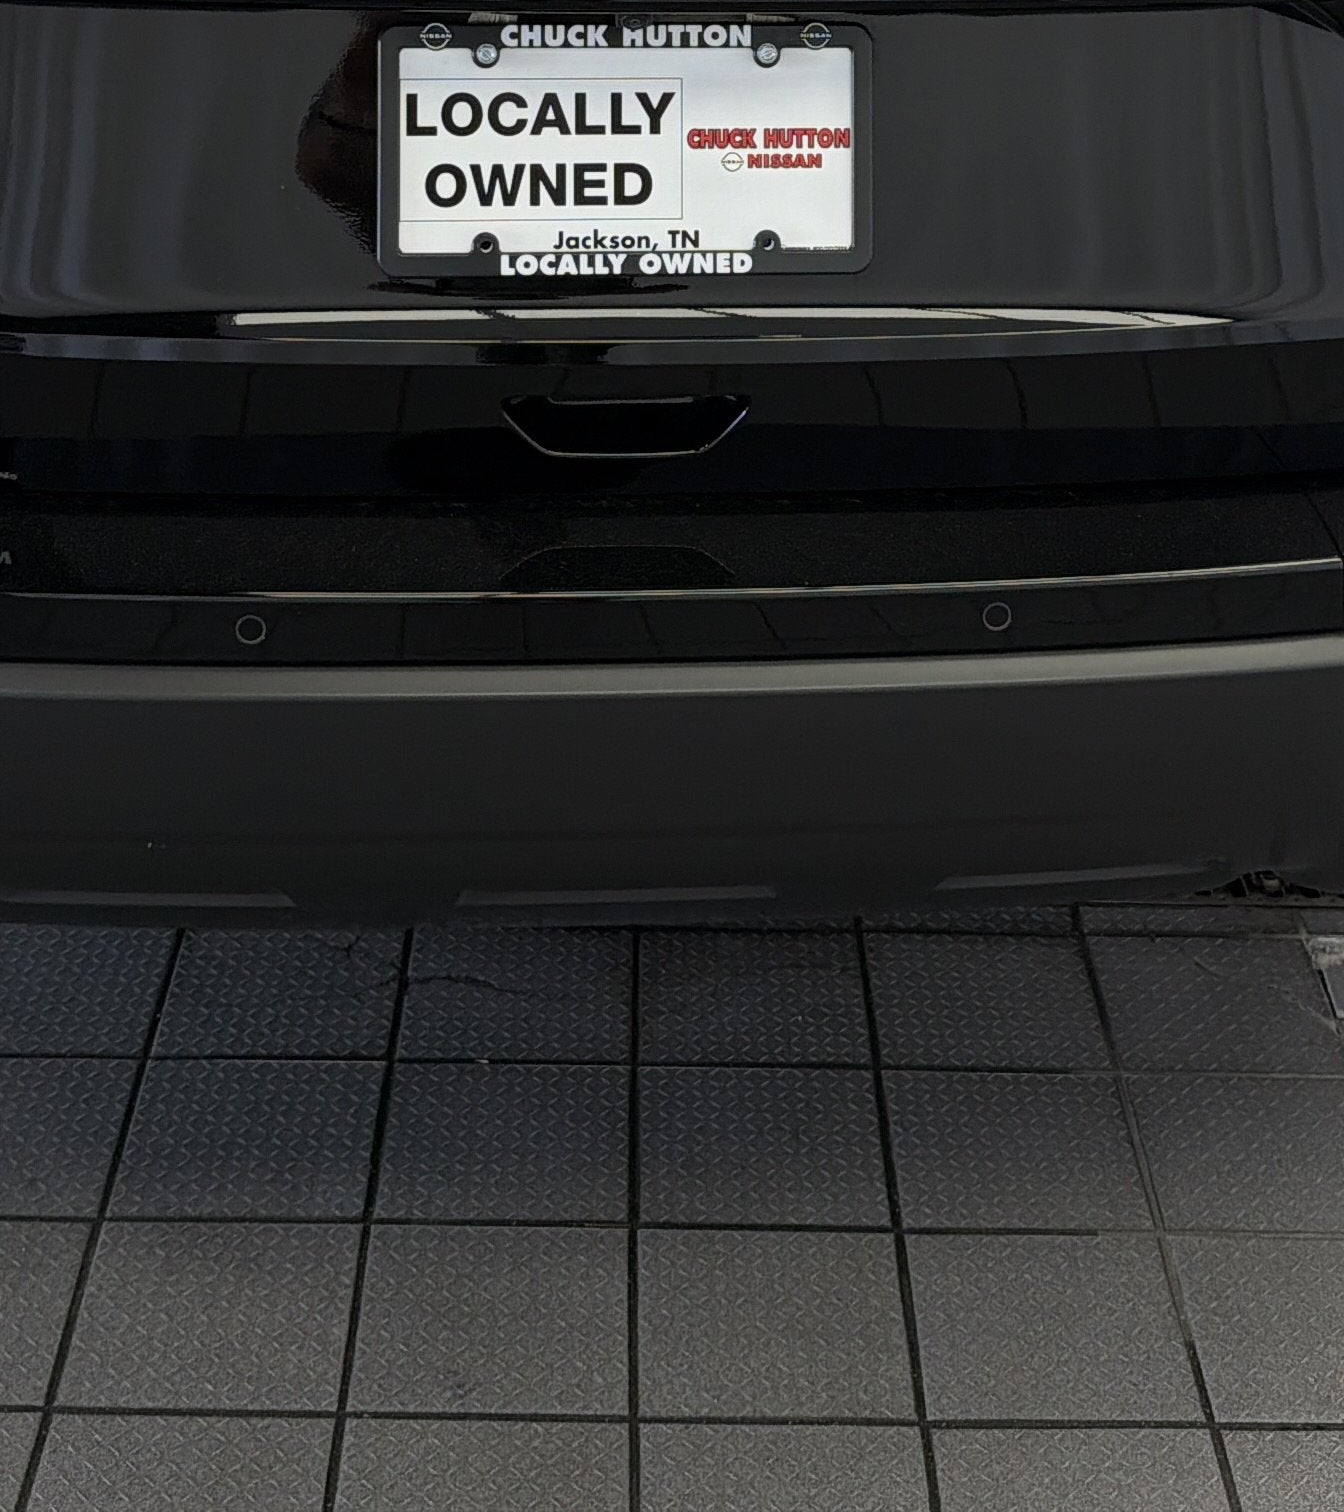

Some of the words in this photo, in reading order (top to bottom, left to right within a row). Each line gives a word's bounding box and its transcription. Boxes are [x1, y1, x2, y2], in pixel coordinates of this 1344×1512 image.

[500, 24, 609, 47] CHUCK
[622, 24, 752, 47] HUTTON
[406, 92, 676, 137] LOCALLY
[687, 128, 757, 149] CHUCK
[763, 128, 851, 149] HUTTON
[747, 153, 823, 169] NISSAN
[425, 163, 653, 208] OWNED
[553, 229, 658, 251] Jackson,
[667, 230, 700, 249] TN
[500, 253, 628, 276] LOCALLY
[639, 253, 753, 275] OWNED
